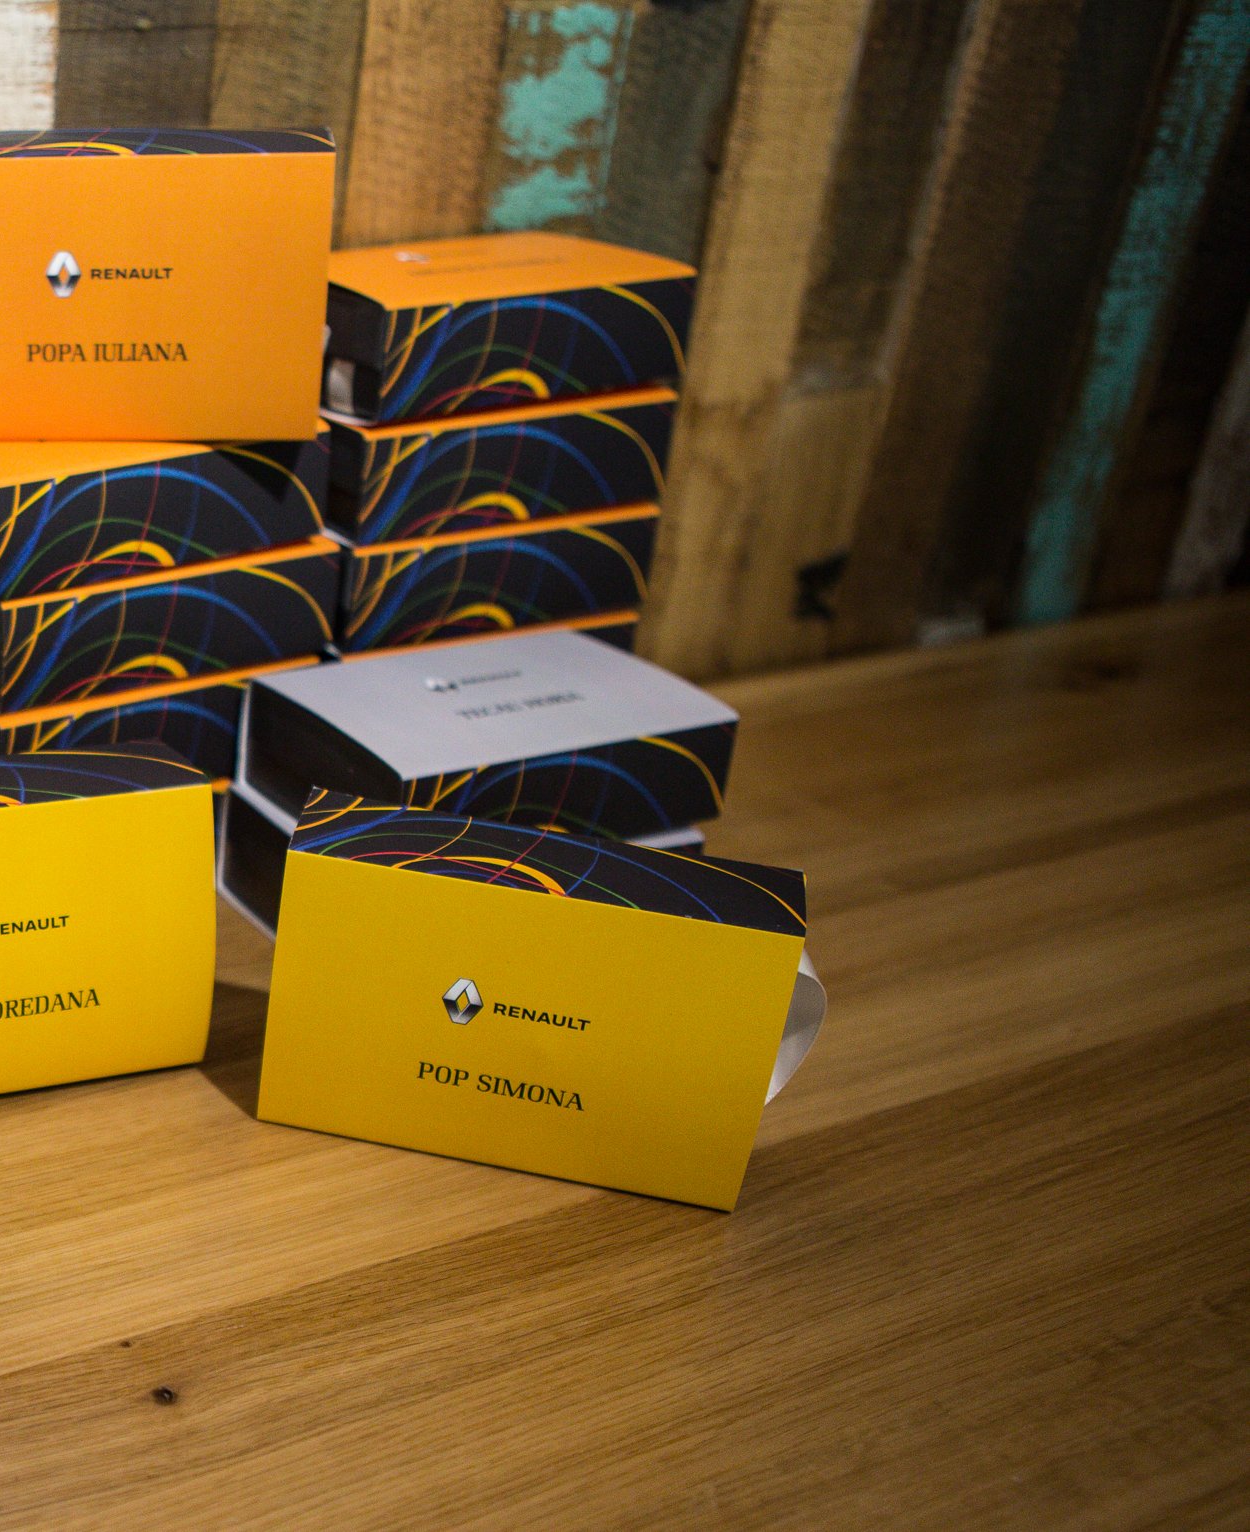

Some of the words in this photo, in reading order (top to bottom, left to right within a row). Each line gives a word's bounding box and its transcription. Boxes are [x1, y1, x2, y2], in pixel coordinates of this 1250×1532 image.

[90, 267, 173, 280] RENAULT
[26, 343, 88, 362] POPA
[94, 343, 189, 362] IULIANA
[493, 1002, 592, 1032] RENAULT
[417, 1061, 471, 1087] POP
[476, 1074, 586, 1112] SIMONA
